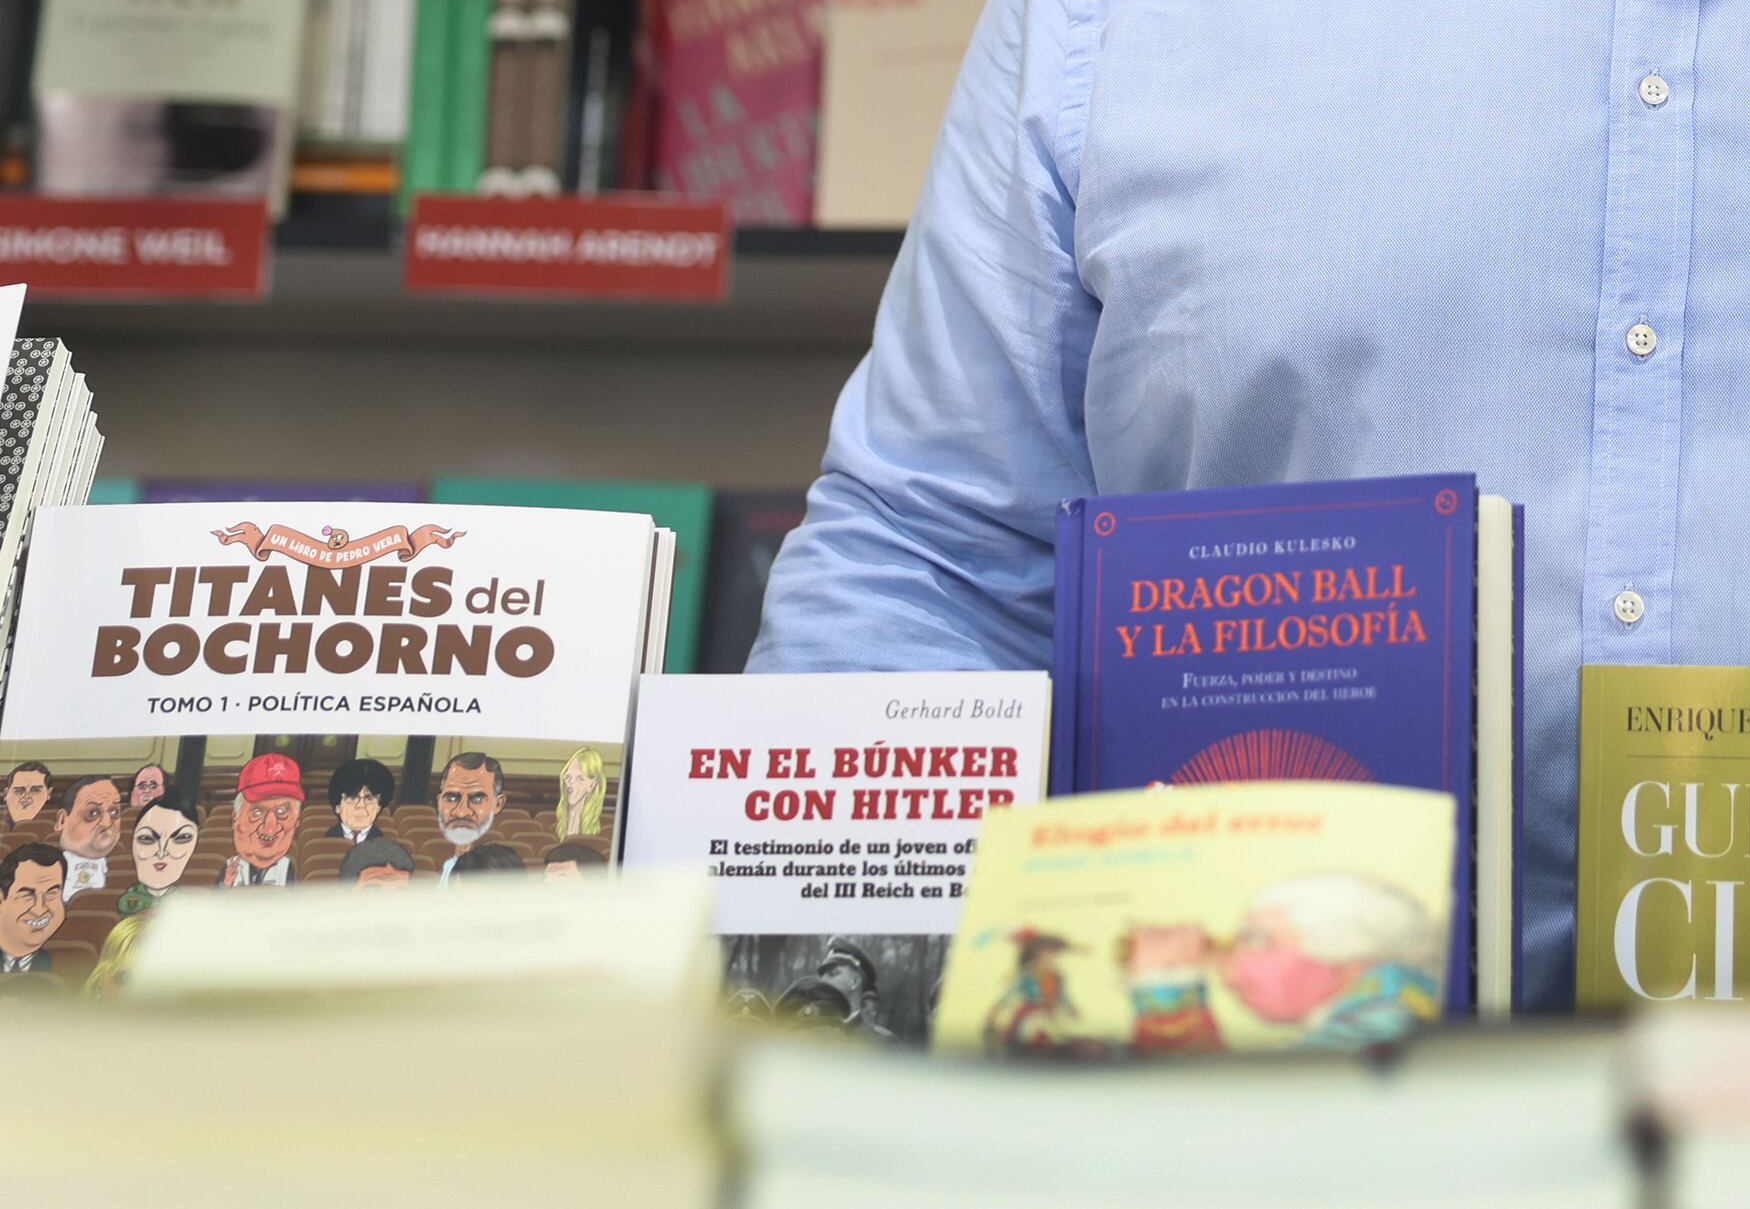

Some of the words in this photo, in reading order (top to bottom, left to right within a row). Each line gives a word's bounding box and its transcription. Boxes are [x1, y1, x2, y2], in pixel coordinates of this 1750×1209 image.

[270, 534, 288, 548] UN
[319, 551, 333, 562] DE
[336, 547, 370, 563] PEDRO
[373, 534, 402, 553] VERA
[1189, 542, 1268, 560] CLAUDIO
[1274, 536, 1356, 556] KULESKO
[121, 565, 454, 619] TITANES
[465, 577, 545, 616] del
[1130, 571, 1302, 613] DRAGON
[1311, 564, 1417, 602] BALL
[1116, 625, 1143, 658] Y
[1152, 623, 1202, 657] LA
[1212, 602, 1428, 654] FILOSOFÍA
[91, 622, 555, 678] BOCHORNO
[1241, 670, 1286, 686] PODER
[1288, 670, 1297, 683] Y
[1301, 667, 1358, 683] DESTINO
[148, 696, 212, 714] TOMO
[221, 696, 228, 712] 1
[248, 691, 351, 712] POLÍTICA
[359, 692, 482, 714] ESPAÑOLA
[886, 699, 964, 721] Gerhard
[970, 699, 1023, 720] Boldt
[1160, 695, 1179, 709] EN
[1181, 694, 1199, 709] LA
[1304, 687, 1328, 702] DEL
[688, 748, 752, 779] EN
[766, 748, 816, 779] EL
[832, 741, 1019, 779] BÚNKER
[744, 788, 836, 821] CON
[851, 788, 1015, 821] HITLER
[709, 839, 729, 855] El
[734, 839, 834, 855] testimonio
[839, 839, 861, 855] de
[866, 843, 890, 855] un
[894, 839, 948, 859] joven
[708, 861, 777, 877] alemán
[783, 861, 857, 877] durante
[862, 861, 888, 876] los
[894, 861, 966, 877] últimos
[801, 882, 829, 898] del
[834, 883, 856, 898] III
[862, 882, 914, 898] Reich
[920, 886, 943, 898] en
